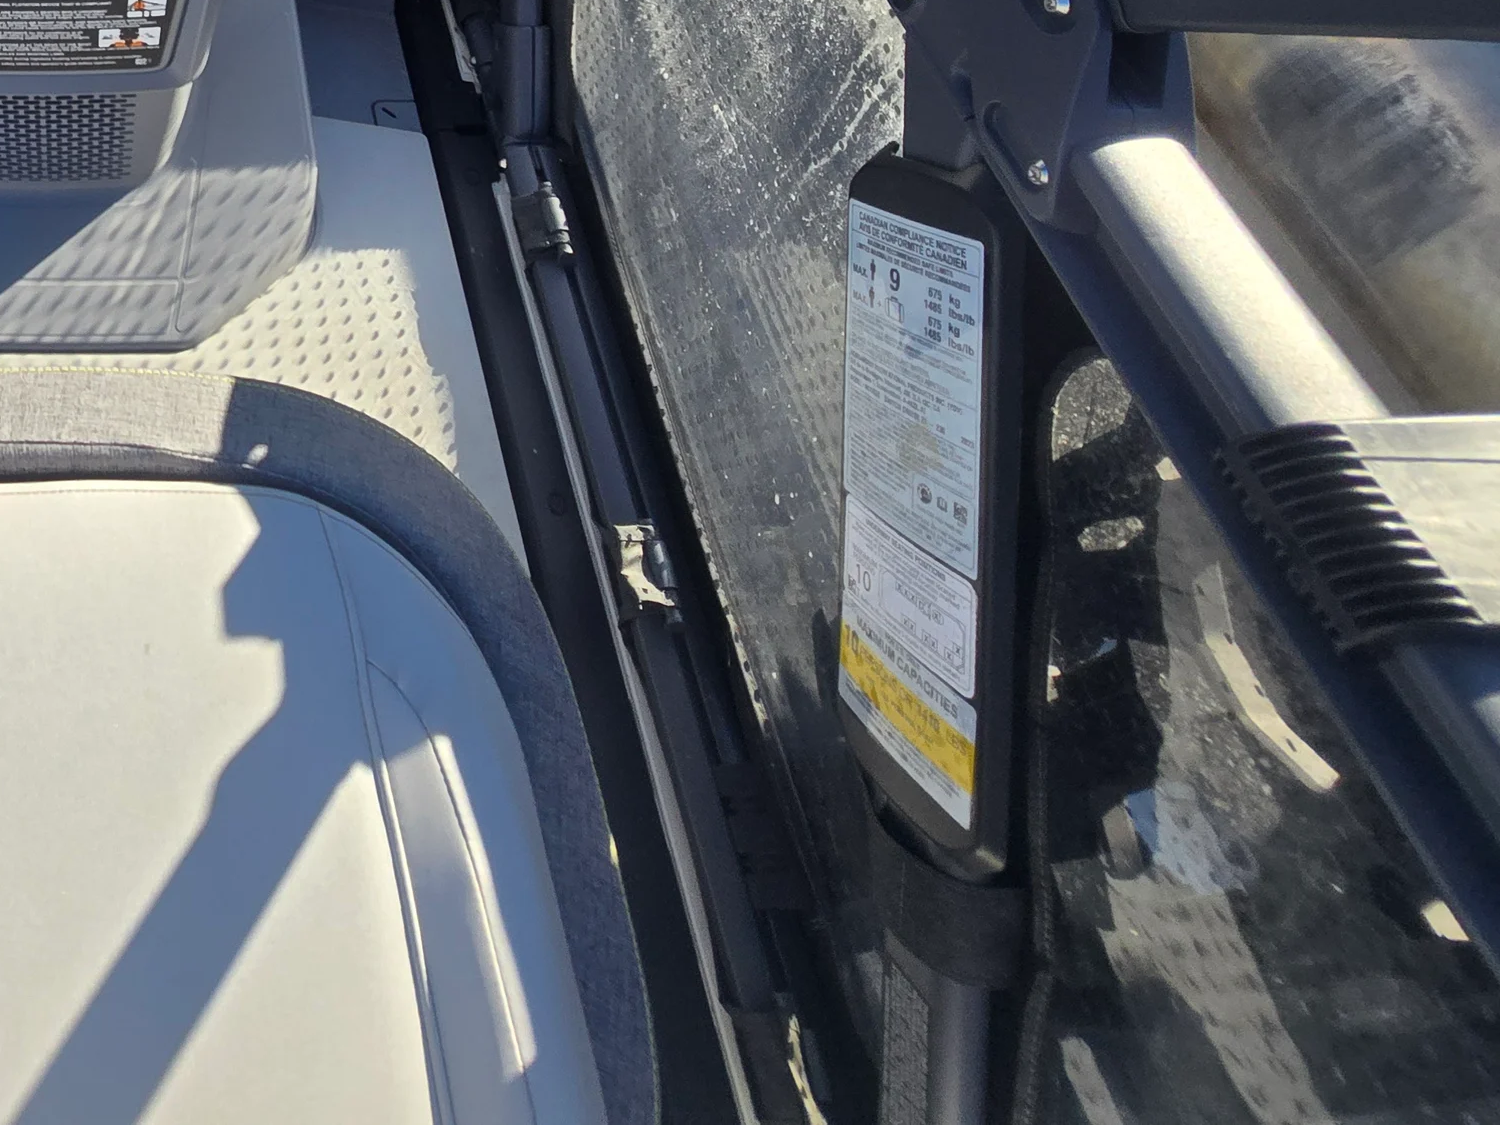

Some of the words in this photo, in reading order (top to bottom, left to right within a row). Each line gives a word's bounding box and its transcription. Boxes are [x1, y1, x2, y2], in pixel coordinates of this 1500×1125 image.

[859, 211, 888, 231] CANADIAN
[890, 222, 934, 248] COMPLIANCE
[936, 236, 966, 259] NOTICE
[859, 222, 871, 234] AVIS
[872, 226, 880, 238] DE
[925, 247, 968, 271] CANADIEN
[890, 268, 900, 292] 9
[928, 287, 942, 301] 675
[949, 294, 961, 309] kg
[924, 299, 942, 315] 1485
[948, 307, 975, 326] lbs/lb
[928, 316, 942, 330] 675
[948, 322, 960, 338] kg
[924, 327, 942, 342] 1485
[948, 337, 975, 356] lbs/lb
[856, 563, 871, 592] 10
[845, 624, 859, 656] 10
[857, 616, 895, 663] MAXIMUM
[896, 657, 958, 720] CAPACITIES
